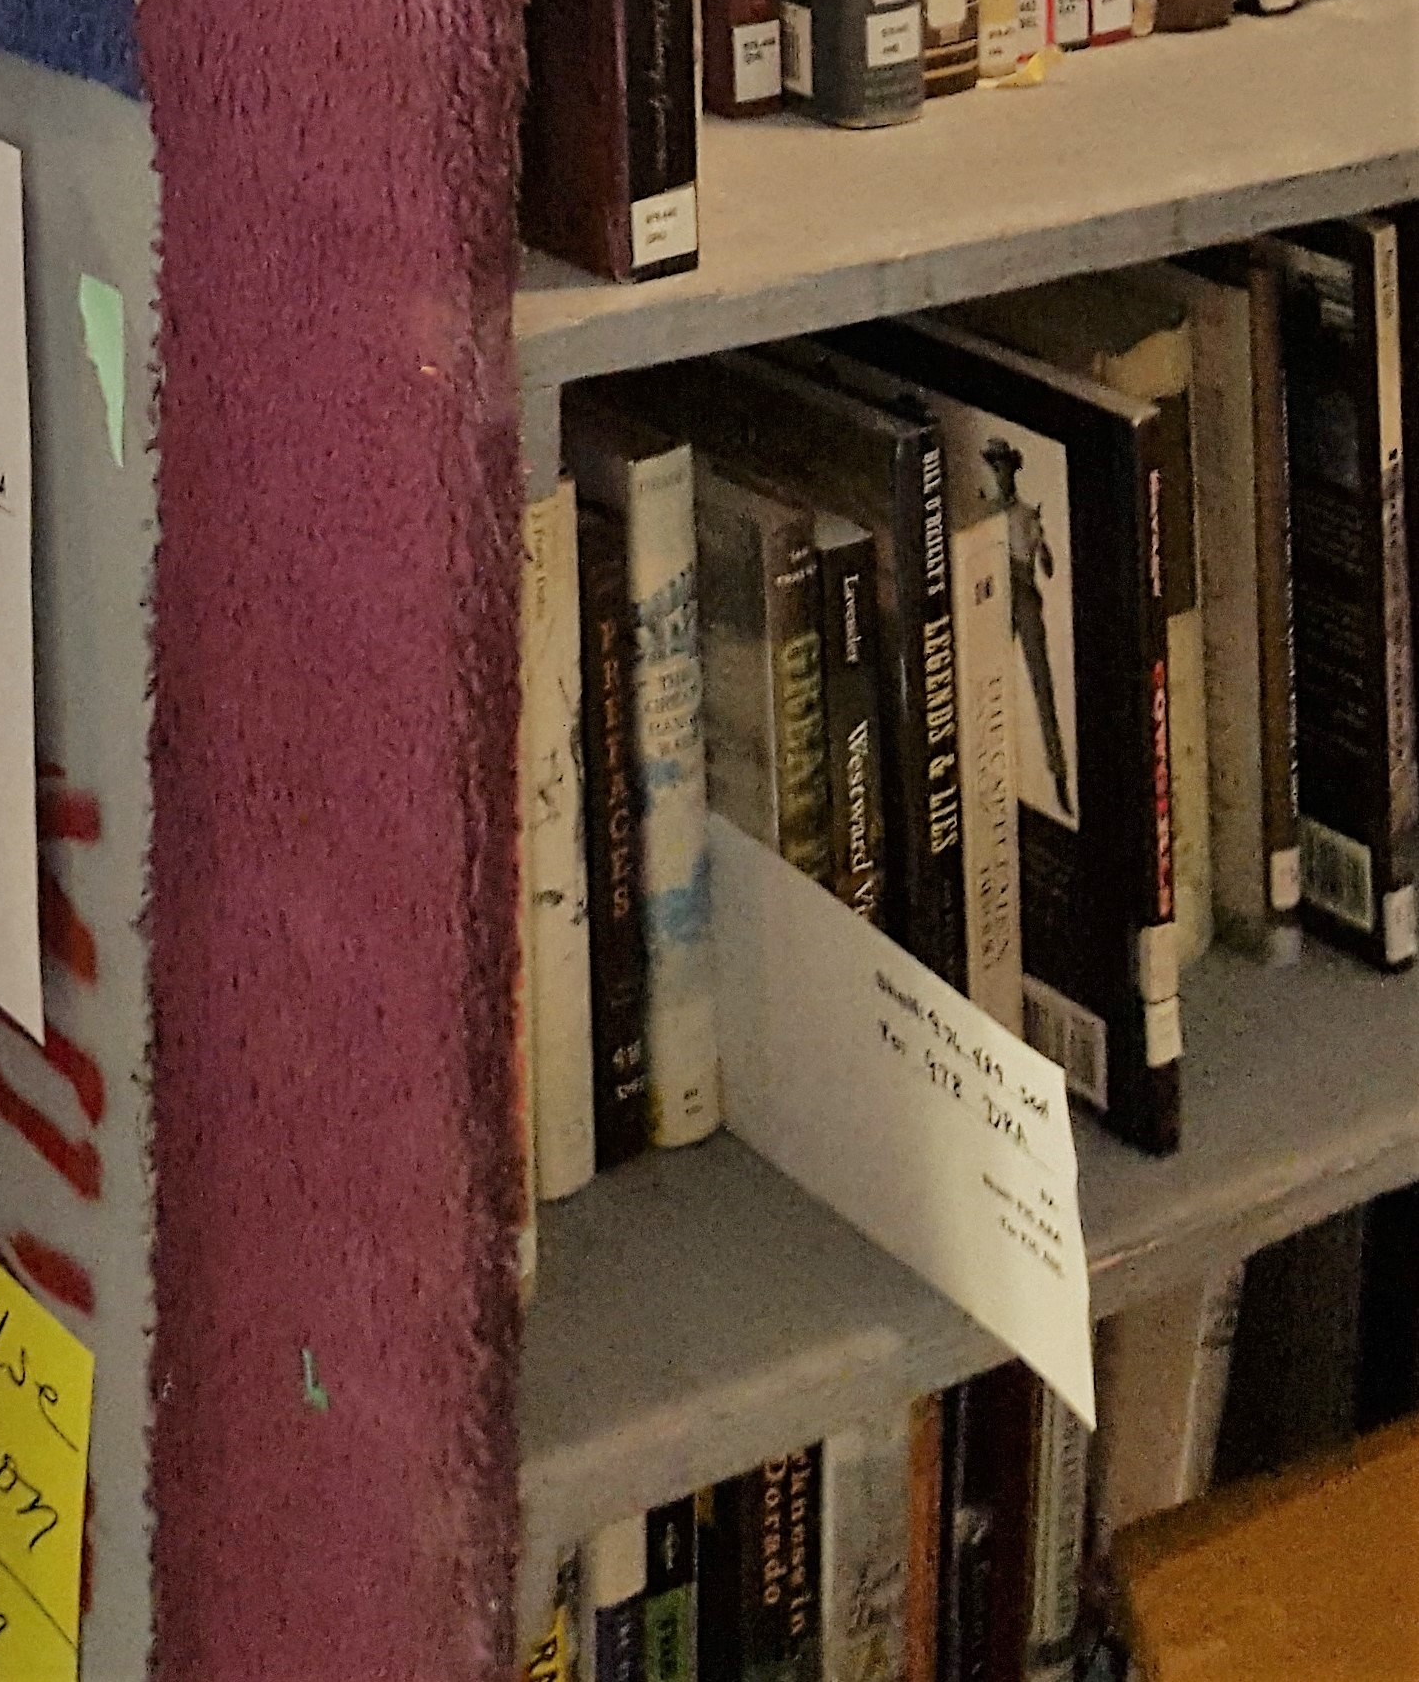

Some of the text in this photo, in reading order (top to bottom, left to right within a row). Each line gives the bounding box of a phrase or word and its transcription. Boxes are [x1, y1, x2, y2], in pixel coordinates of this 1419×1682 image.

[922, 446, 942, 493] BILL
[924, 614, 956, 746] LEGENDS
[846, 719, 874, 875] Westward
[927, 752, 956, 782] &
[928, 785, 959, 855] LIES
